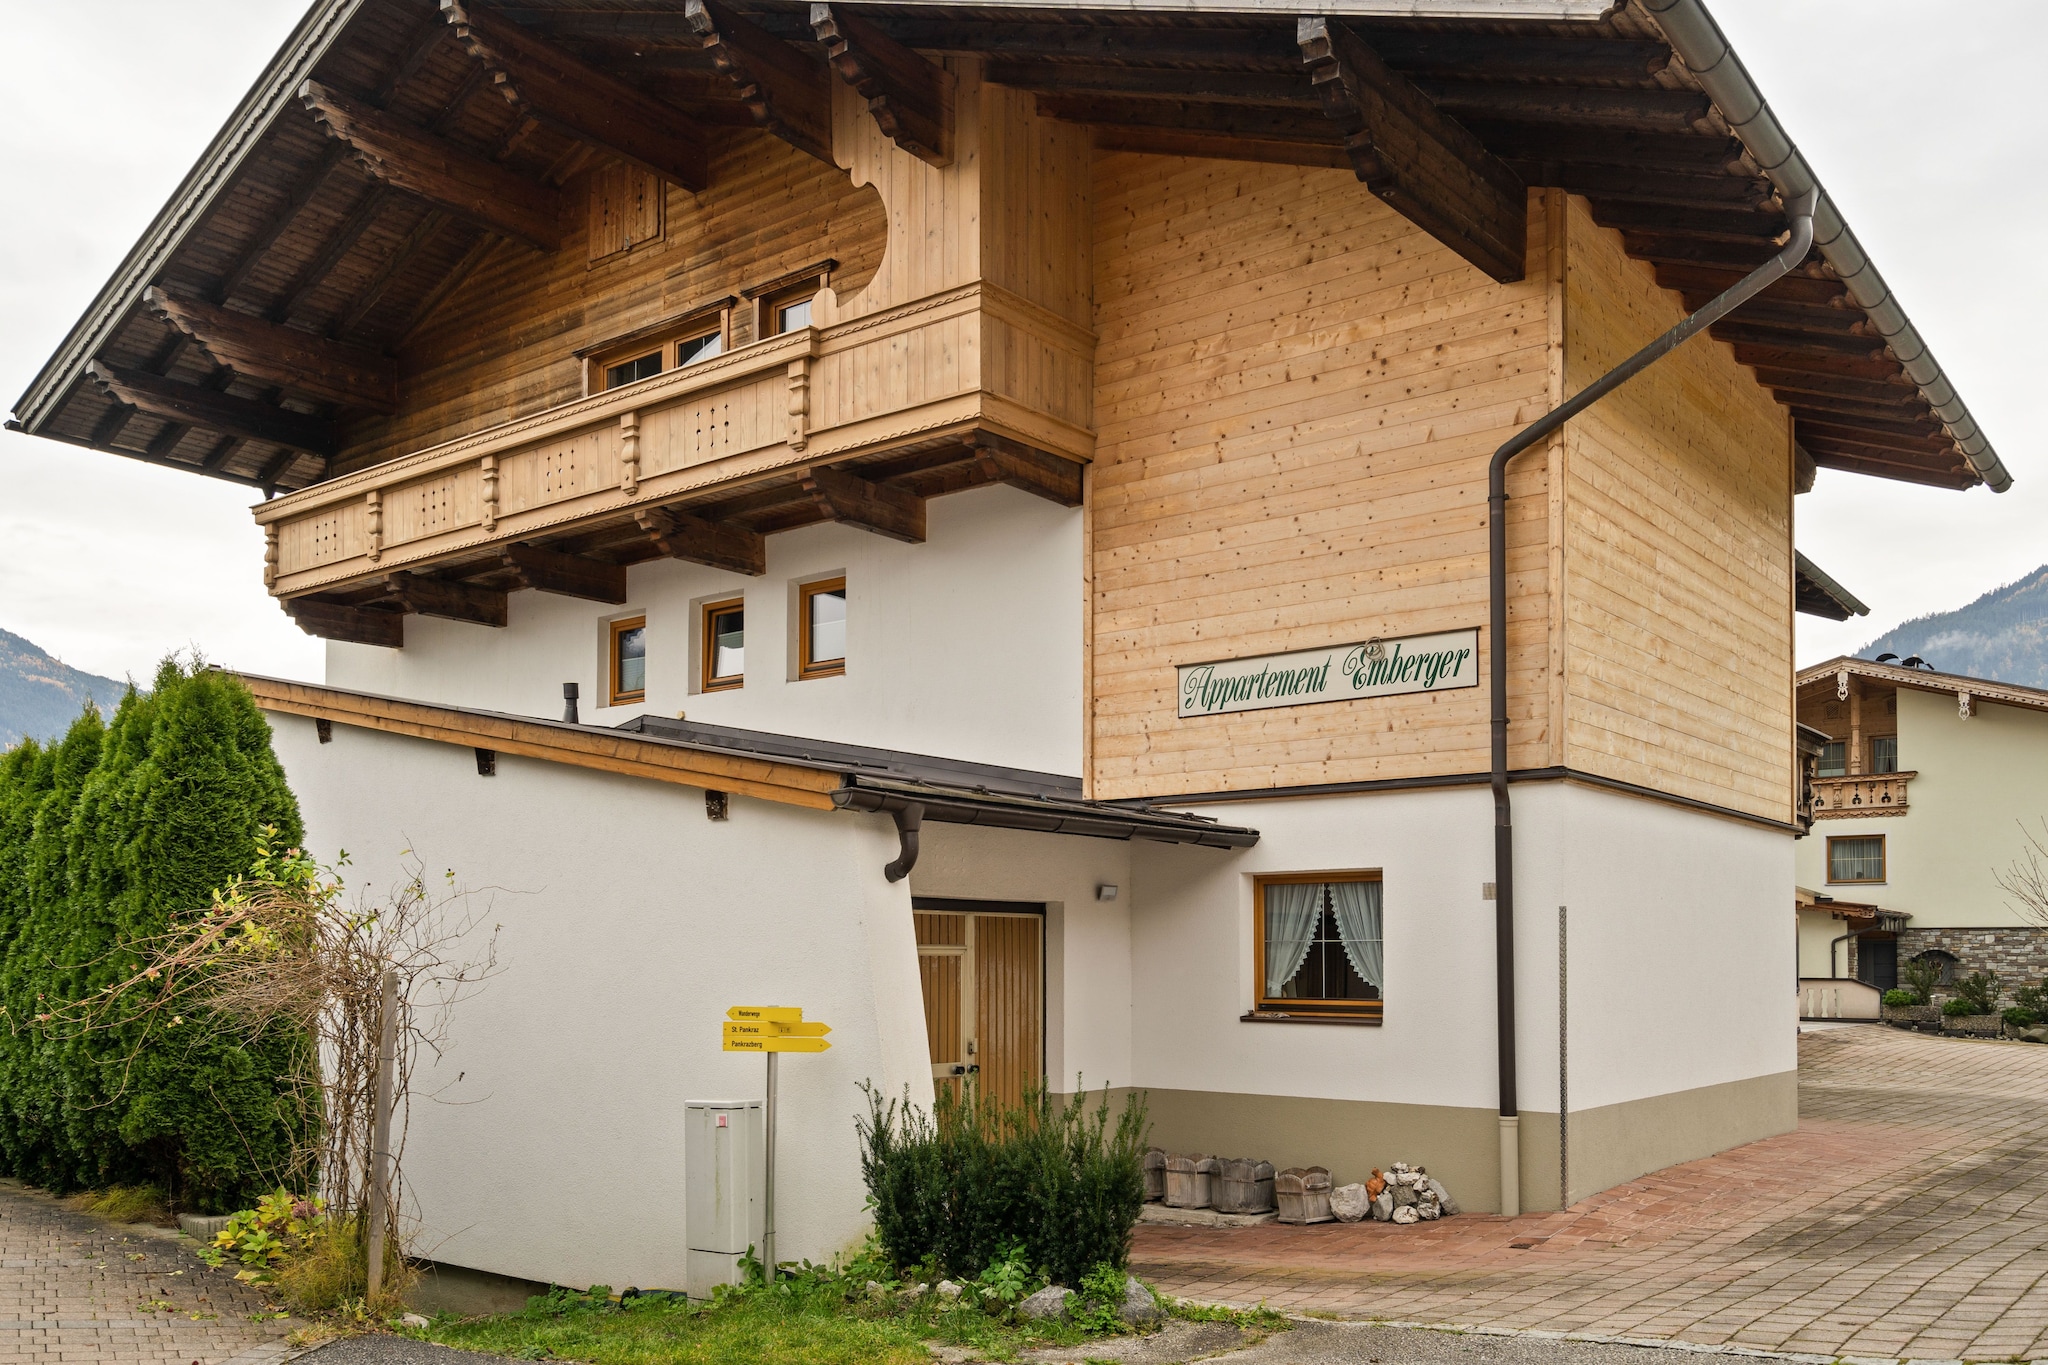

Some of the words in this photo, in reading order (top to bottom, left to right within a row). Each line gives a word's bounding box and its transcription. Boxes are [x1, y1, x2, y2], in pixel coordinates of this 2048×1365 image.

[1183, 654, 1332, 711] Appartement
[1342, 643, 1470, 690] Emberger
[738, 1010, 760, 1018] Wanderwege
[731, 1040, 762, 1049] Pankrazberg
